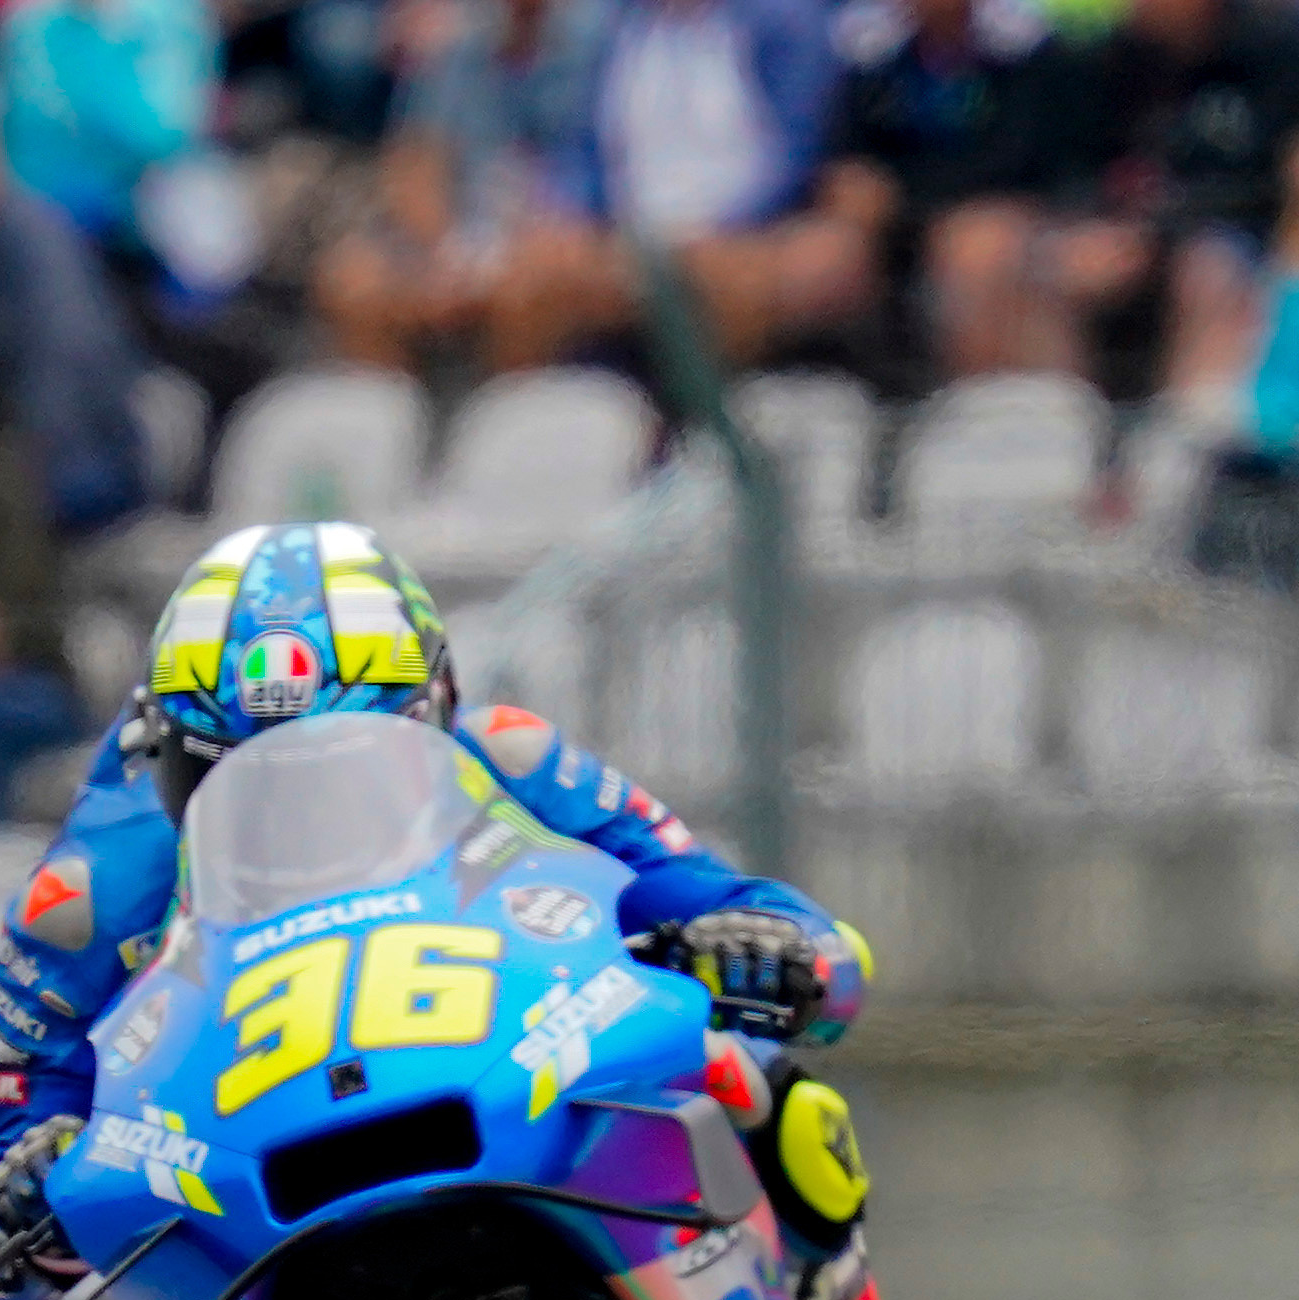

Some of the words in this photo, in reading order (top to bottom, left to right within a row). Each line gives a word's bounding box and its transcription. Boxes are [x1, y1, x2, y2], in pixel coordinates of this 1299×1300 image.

[233, 892, 422, 963] SUZUKI
[215, 921, 505, 1119] 36
[510, 965, 635, 1072] SUZUKI
[96, 1115, 209, 1174] SUZUKI
